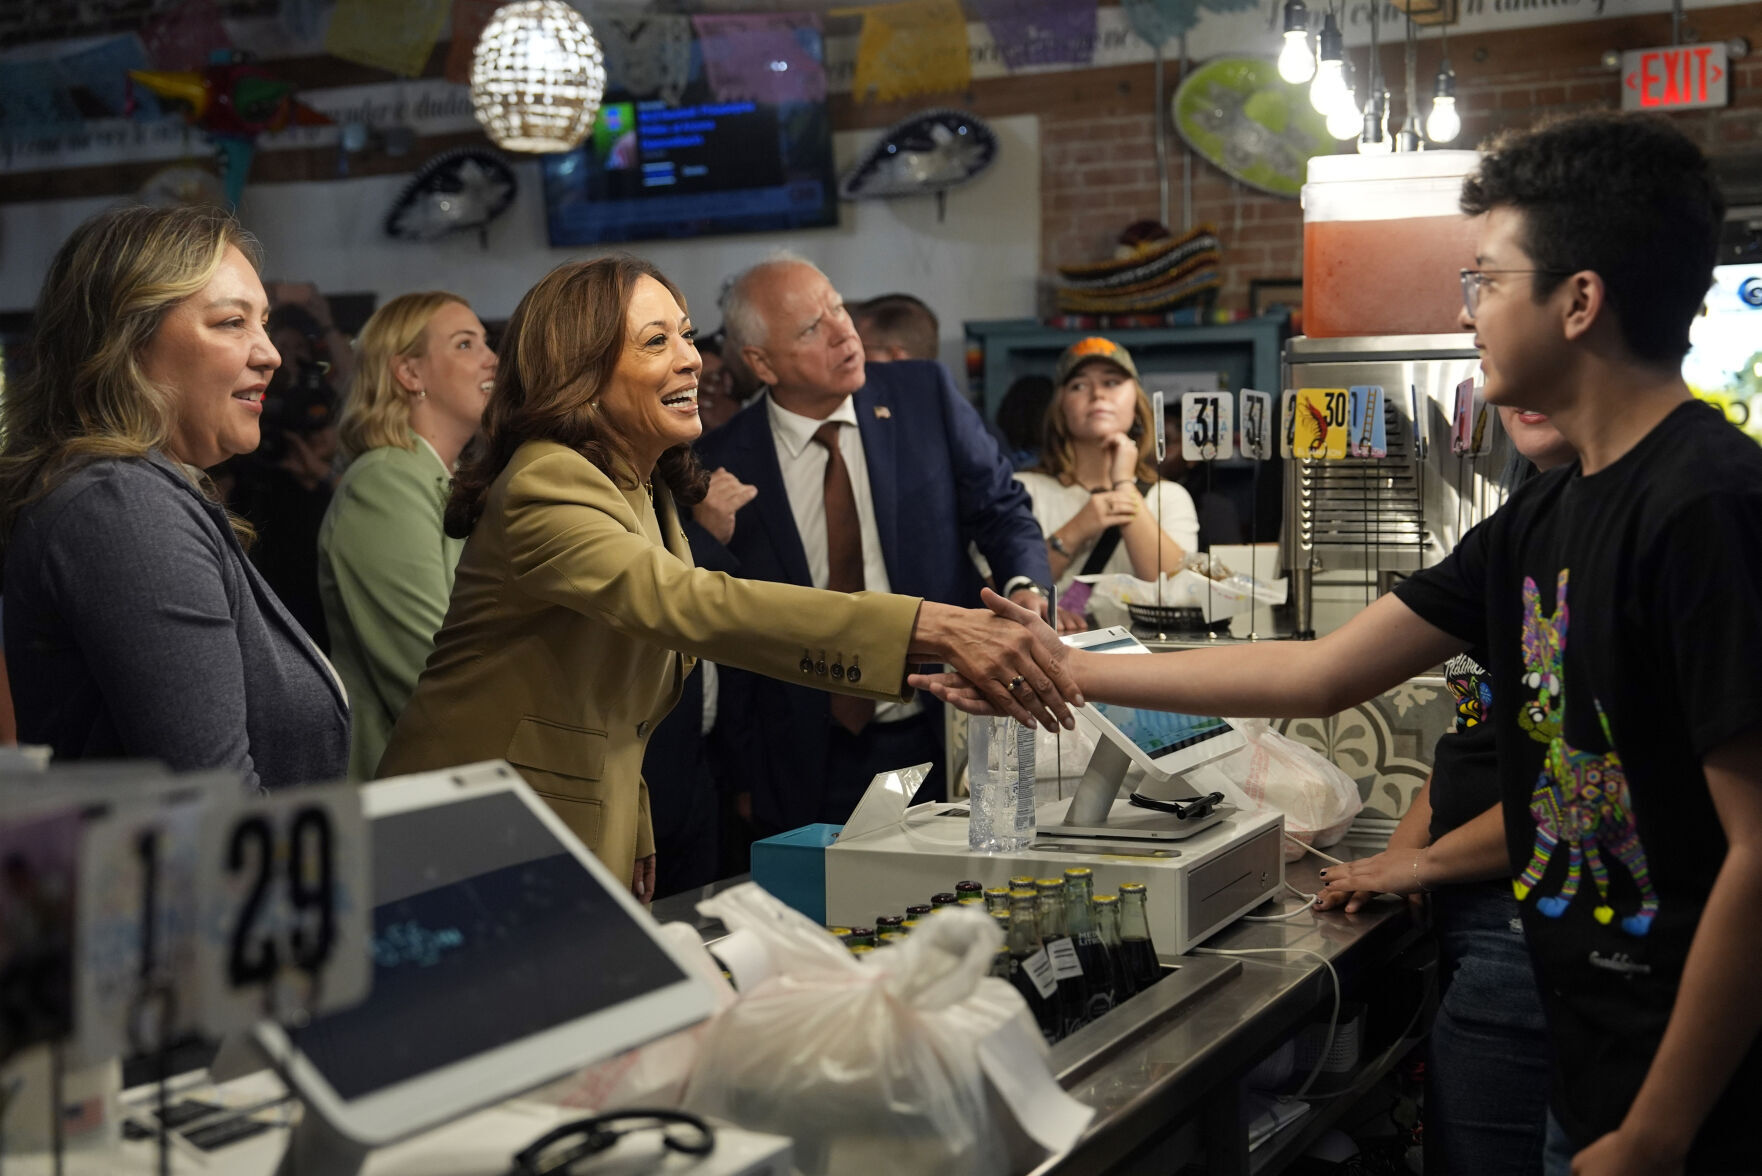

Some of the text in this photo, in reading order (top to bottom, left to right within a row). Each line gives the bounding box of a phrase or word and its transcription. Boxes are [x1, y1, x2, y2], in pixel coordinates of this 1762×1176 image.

[1640, 47, 1712, 106] EXIT
[1193, 397, 1219, 448] 31
[1324, 392, 1347, 427] 30
[226, 804, 337, 988] 29
